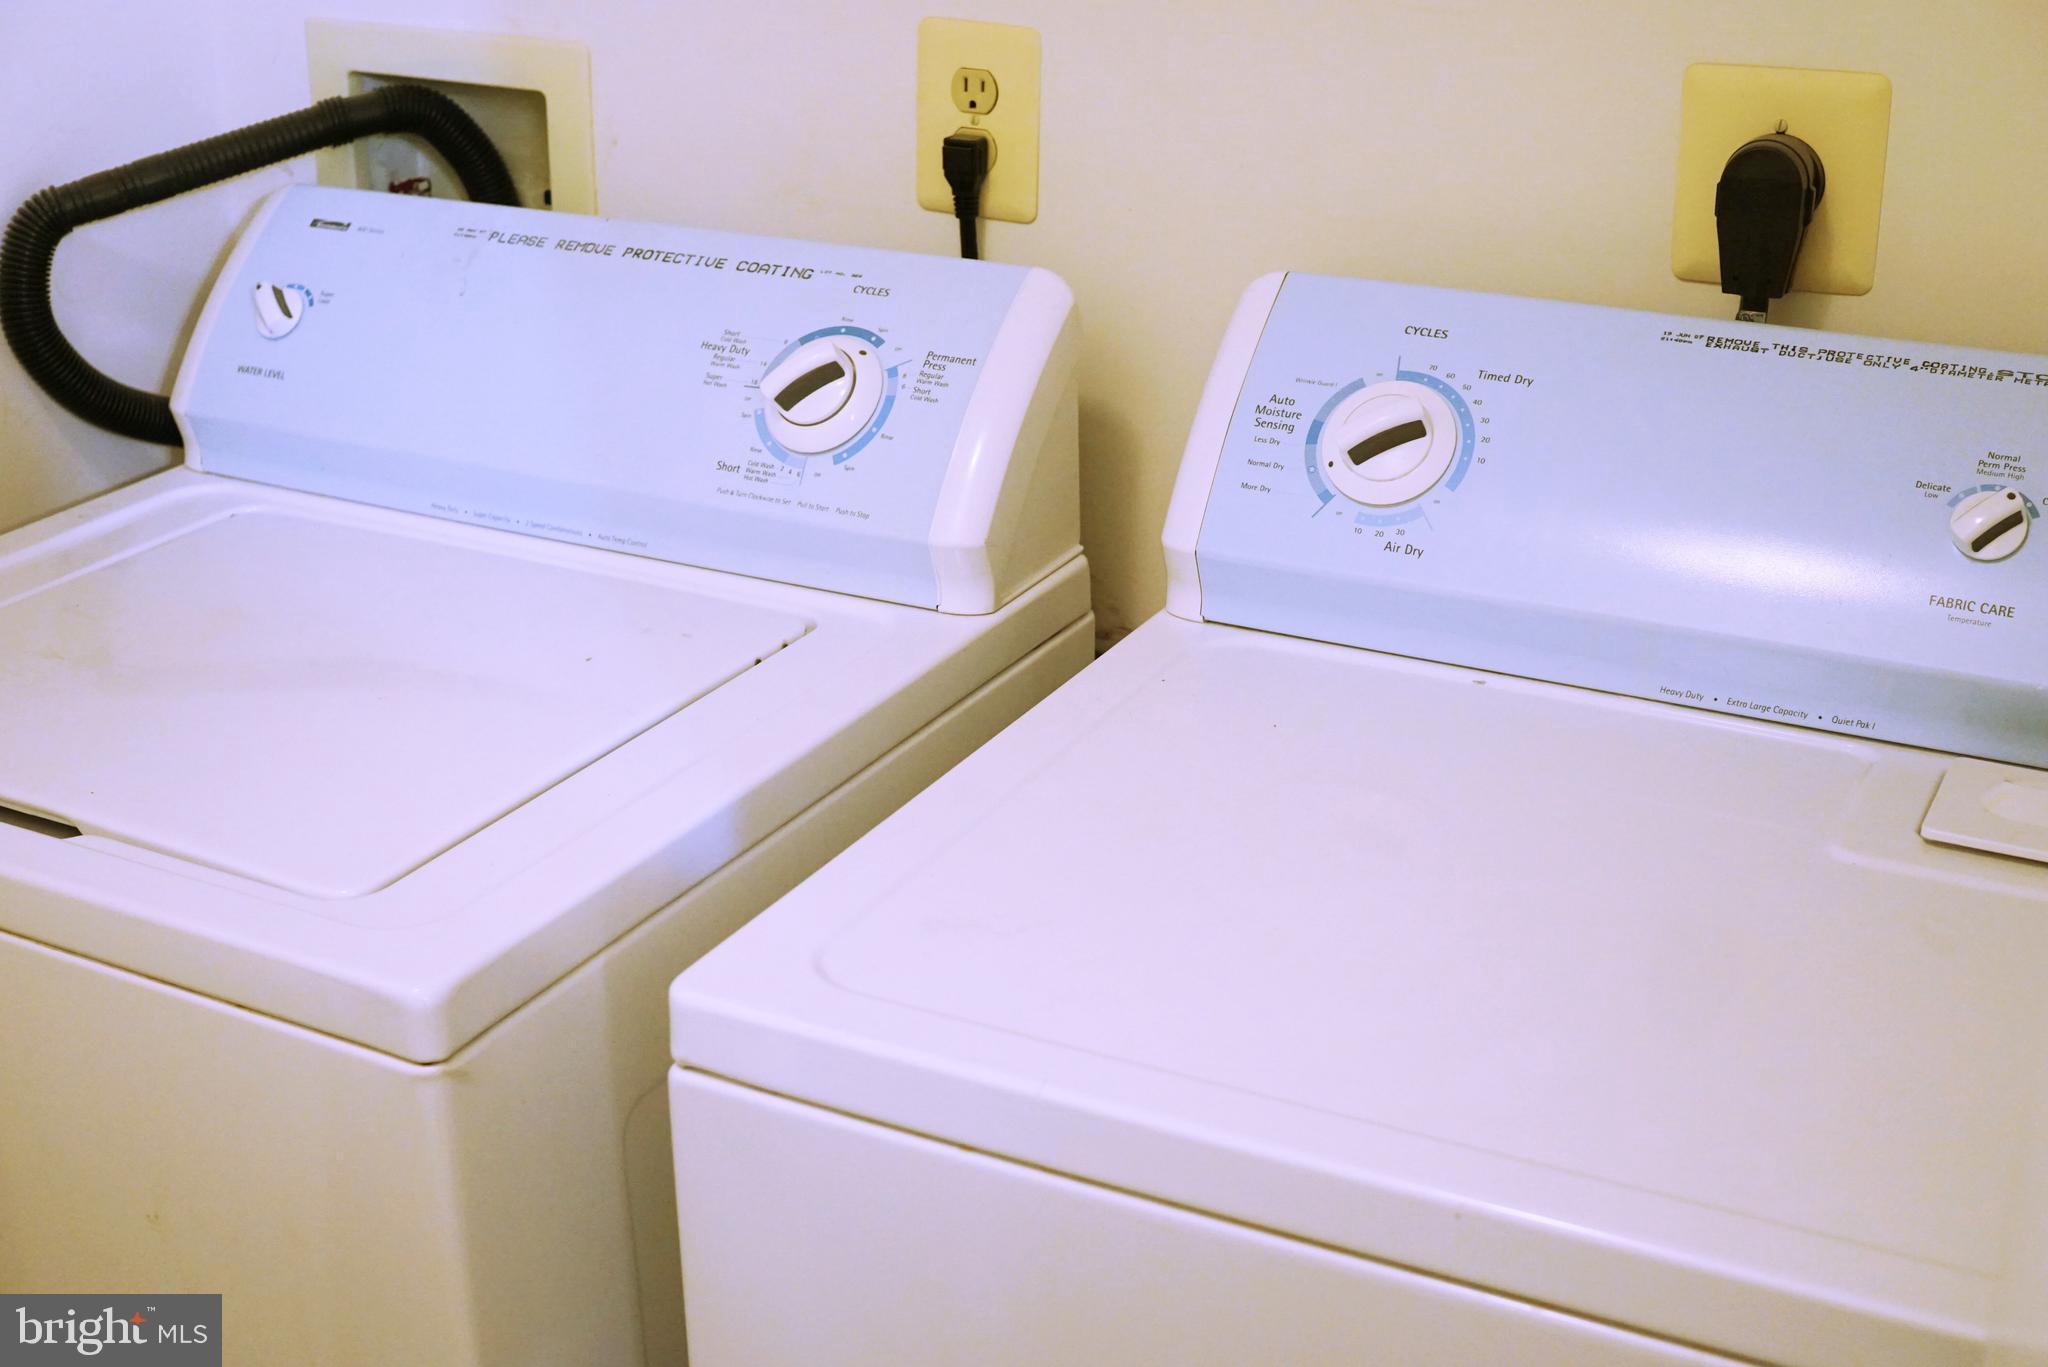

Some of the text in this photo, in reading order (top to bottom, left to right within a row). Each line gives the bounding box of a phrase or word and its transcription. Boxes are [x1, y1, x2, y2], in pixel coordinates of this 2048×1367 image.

[488, 231, 548, 248] PLEASE
[555, 239, 616, 256] REMOVE
[621, 247, 728, 269] PROTECTIVE
[736, 260, 815, 280] COATING
[853, 284, 890, 297] CYCLES
[1404, 325, 1449, 340] CYCLES
[700, 340, 751, 356] Heavy Duty
[1705, 341, 1770, 354] EXHAUST
[1863, 360, 1902, 369] ONLY
[1706, 335, 1761, 349] REMOVE
[1771, 342, 1809, 354] THIS
[1817, 348, 1911, 366] PROTECTIVE
[923, 360, 946, 371] Press
[926, 351, 977, 367] Permanent
[238, 365, 285, 380] WATER LEVEL
[919, 371, 944, 380] Regular
[1478, 369, 1534, 388] Timed Dry
[912, 387, 931, 395] Short
[1269, 393, 1296, 406] Auto
[1254, 404, 1303, 420] Moisture
[1253, 417, 1295, 434] Sensing
[1254, 436, 1281, 446] Less Dry
[1988, 451, 2021, 463] Normal
[716, 460, 741, 474] Short
[1247, 458, 1285, 471] Normal Dry
[1978, 459, 2027, 473] Perm Press
[1976, 468, 2025, 481] Medium High
[1240, 482, 1271, 493] More Dry
[1915, 480, 1952, 493] Delicate
[1924, 491, 1939, 499] Low
[835, 507, 848, 516] Push
[857, 511, 870, 520] Stop
[1395, 528, 1405, 536] 30
[1383, 540, 1424, 559] Air Dry
[1929, 594, 2016, 619] FABRIC CARE
[1947, 614, 1992, 628] Temperature
[1660, 686, 1704, 703] Heavy Duty
[1726, 697, 1808, 720] Extra Large Capacity
[1831, 715, 1854, 726] Quiet
[1856, 719, 1870, 729] Pak
